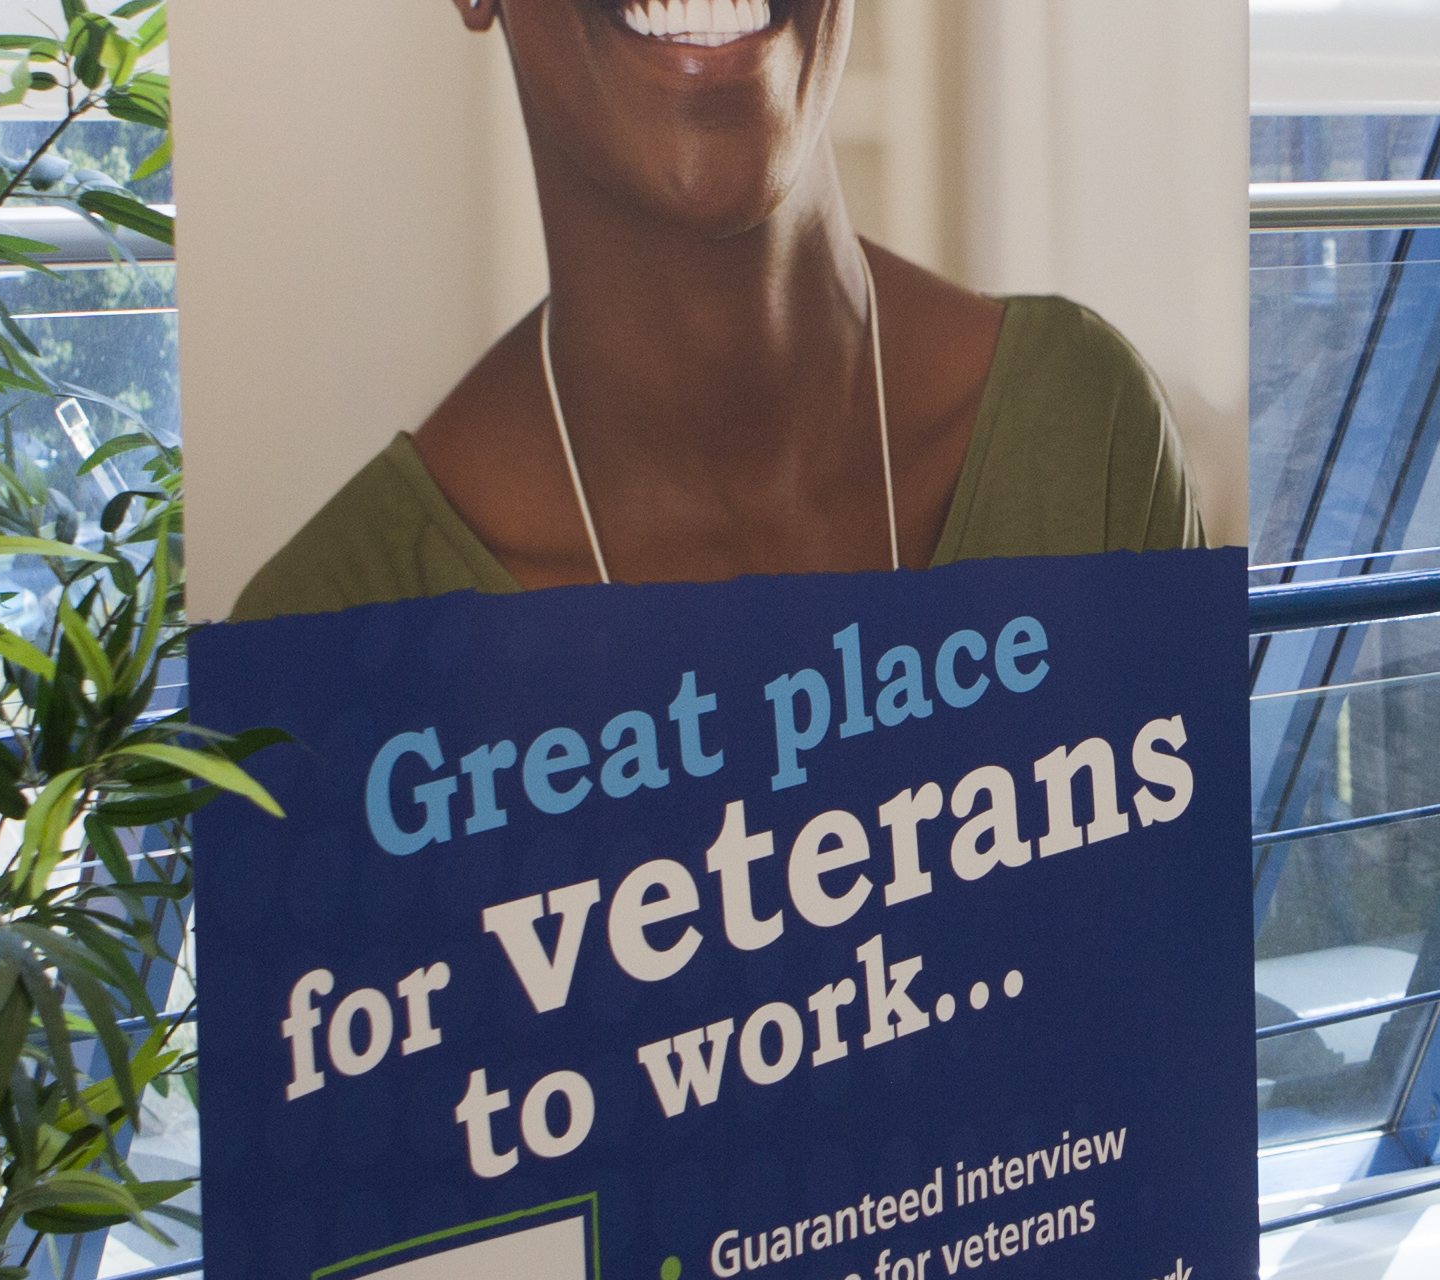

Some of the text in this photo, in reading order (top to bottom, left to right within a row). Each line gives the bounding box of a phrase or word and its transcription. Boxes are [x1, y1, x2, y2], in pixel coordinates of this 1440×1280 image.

[365, 615, 1050, 856] Great place
[280, 714, 1194, 1102] for veterans
[455, 933, 1024, 1179] to work...
[710, 1127, 1127, 1279] Guaranteed interview
[941, 1198, 1096, 1275] veterans
